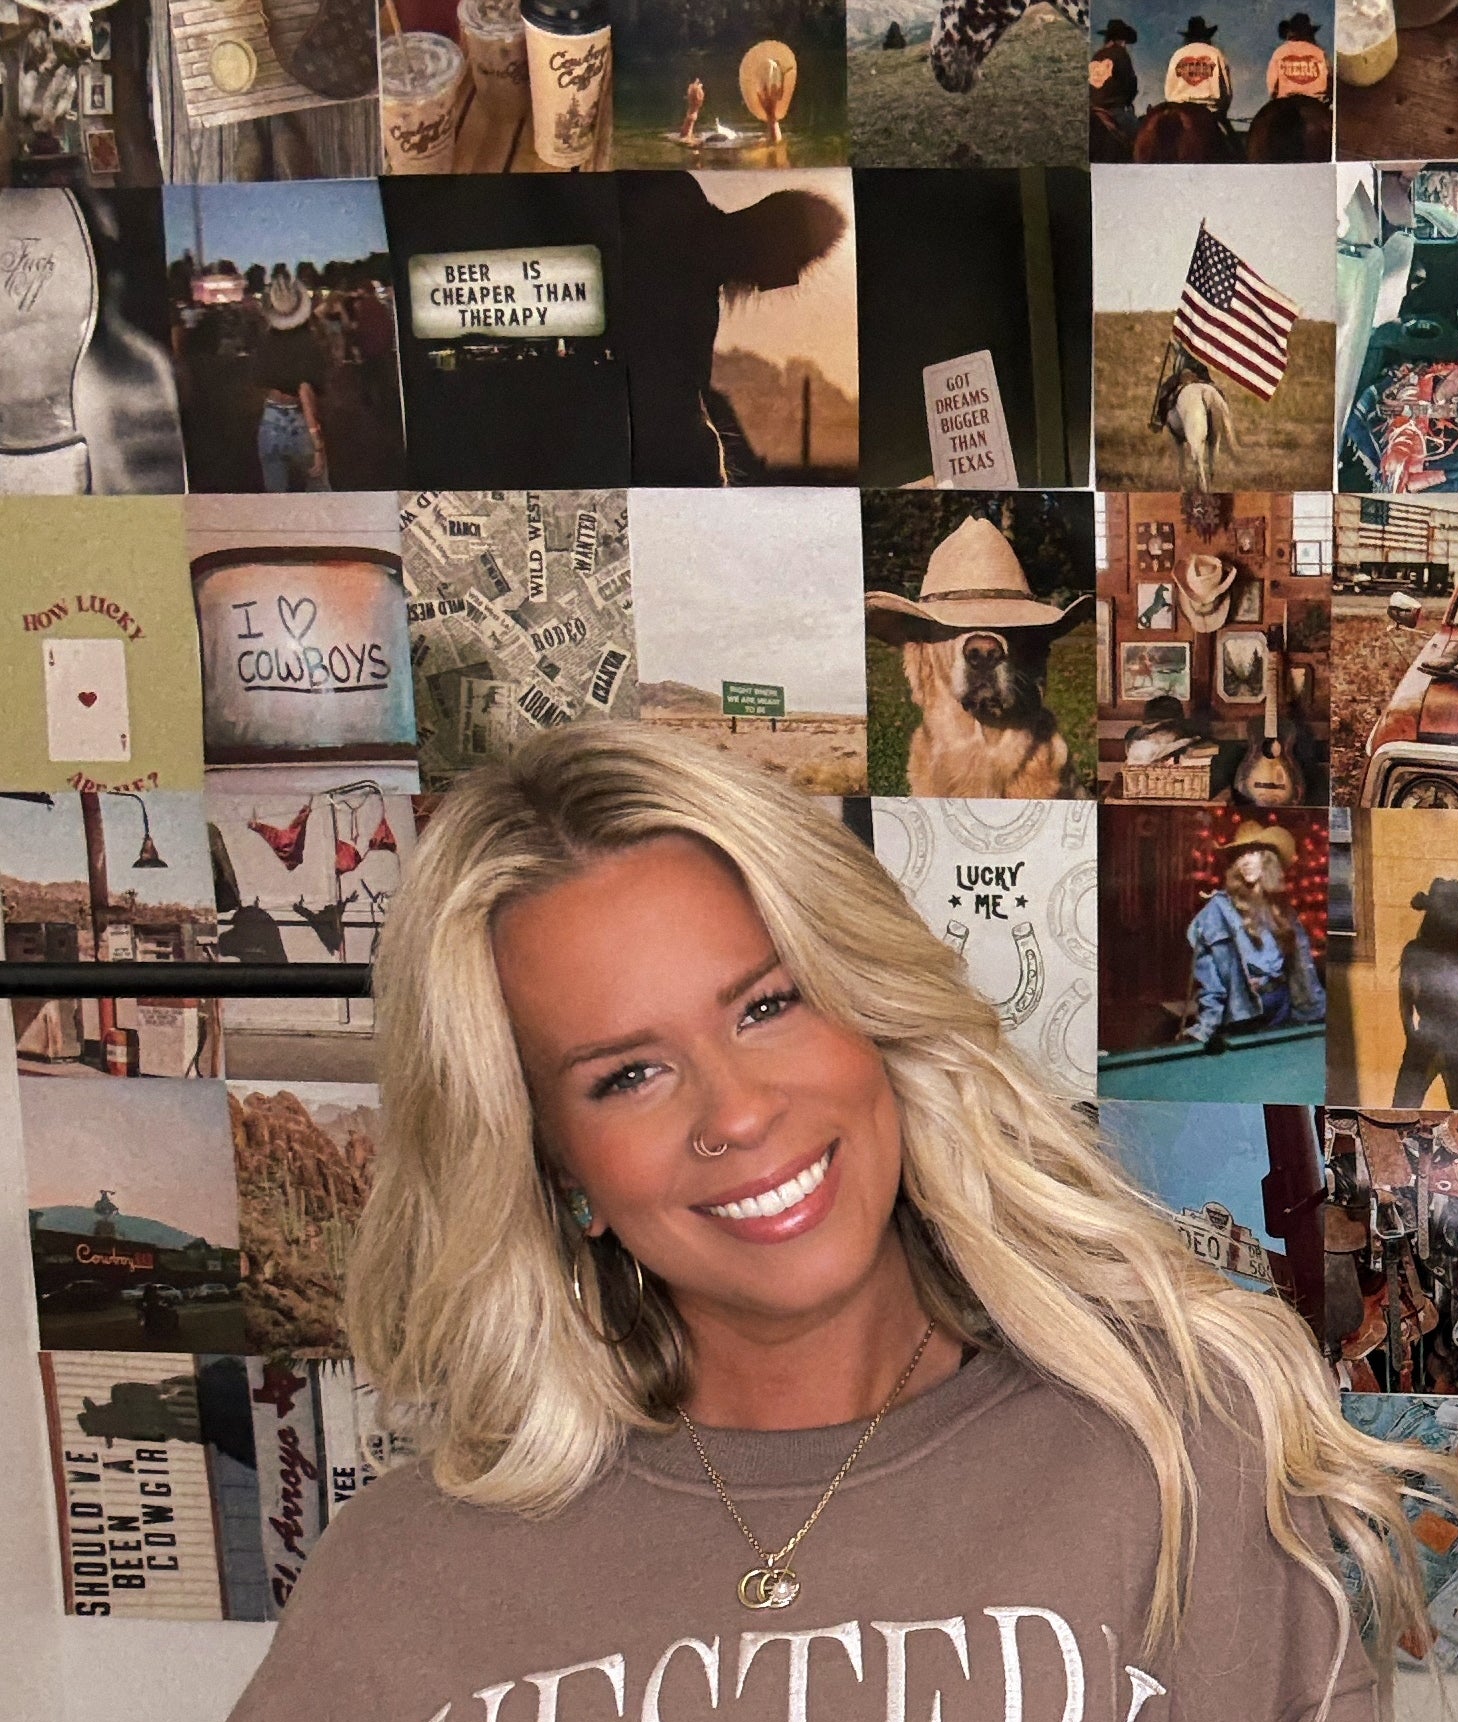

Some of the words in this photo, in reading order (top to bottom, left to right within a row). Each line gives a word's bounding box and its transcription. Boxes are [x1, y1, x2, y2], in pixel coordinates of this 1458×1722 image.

[445, 263, 491, 284] BEER
[522, 260, 542, 281] IS
[430, 285, 516, 307] CHEAPER
[533, 282, 587, 303] THAN
[458, 306, 548, 328] THERAPY
[946, 372, 971, 392] GOT
[935, 387, 989, 415] DREAMS
[940, 408, 990, 434] BIGGER
[949, 430, 988, 453] THAN
[949, 451, 995, 476] TEXAS
[526, 490, 542, 541] WEST
[574, 513, 598, 572] WANTED
[529, 549, 544, 598] WILD
[22, 597, 70, 633] HOW
[76, 595, 146, 643] LUCKY
[232, 600, 264, 639] I
[407, 601, 436, 621] WES
[530, 617, 587, 653] RODEO
[238, 643, 391, 688] COWBOYS
[956, 861, 1025, 891] LUCKY
[975, 894, 1008, 920] ME
[77, 1243, 135, 1273] Cowboy
[102, 1459, 136, 1474] A
[268, 1425, 318, 1561] Arroyo
[332, 1466, 356, 1503] YEE
[136, 1448, 179, 1571] COWGIR
[107, 1515, 146, 1589] BEEN
